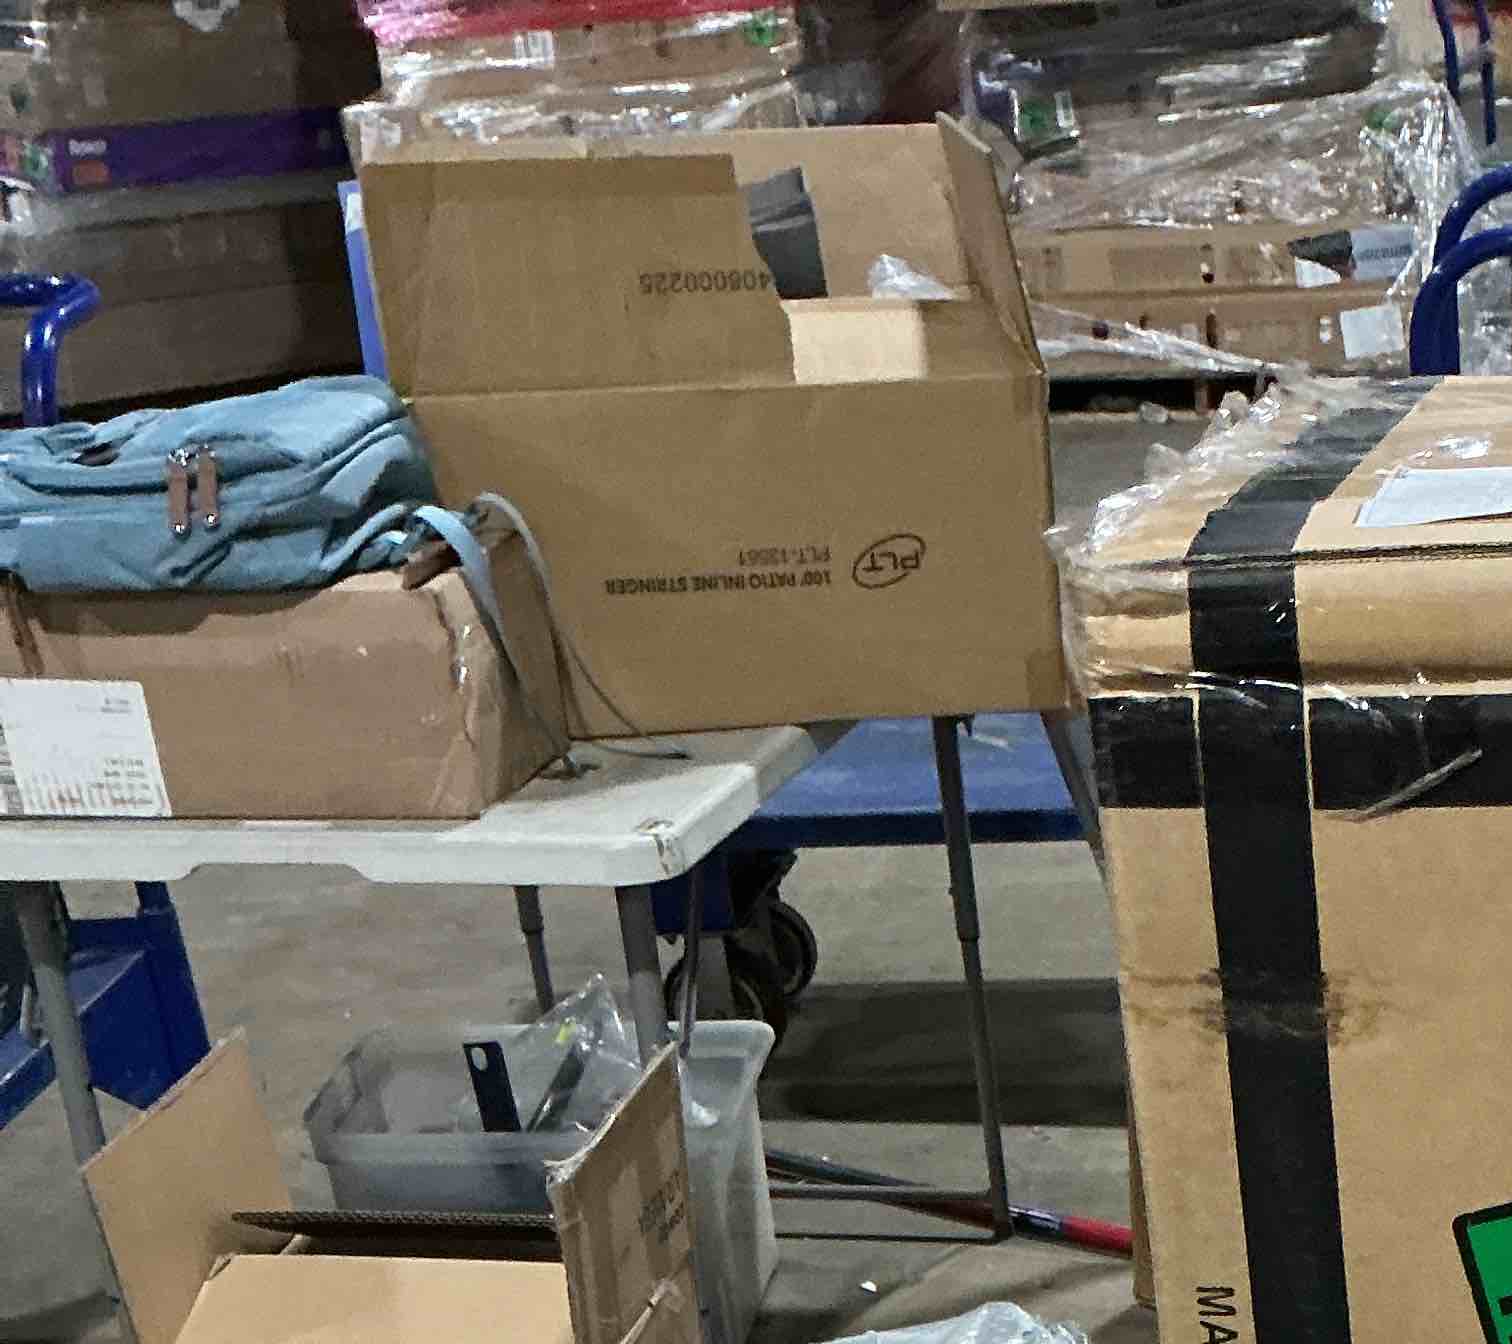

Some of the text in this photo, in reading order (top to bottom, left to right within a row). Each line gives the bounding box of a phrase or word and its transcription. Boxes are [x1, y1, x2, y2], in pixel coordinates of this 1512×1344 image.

[862, 550, 920, 572] PLT
[604, 575, 689, 595] STRINGER
[692, 573, 746, 592] INLINE
[749, 571, 797, 590] PATIO
